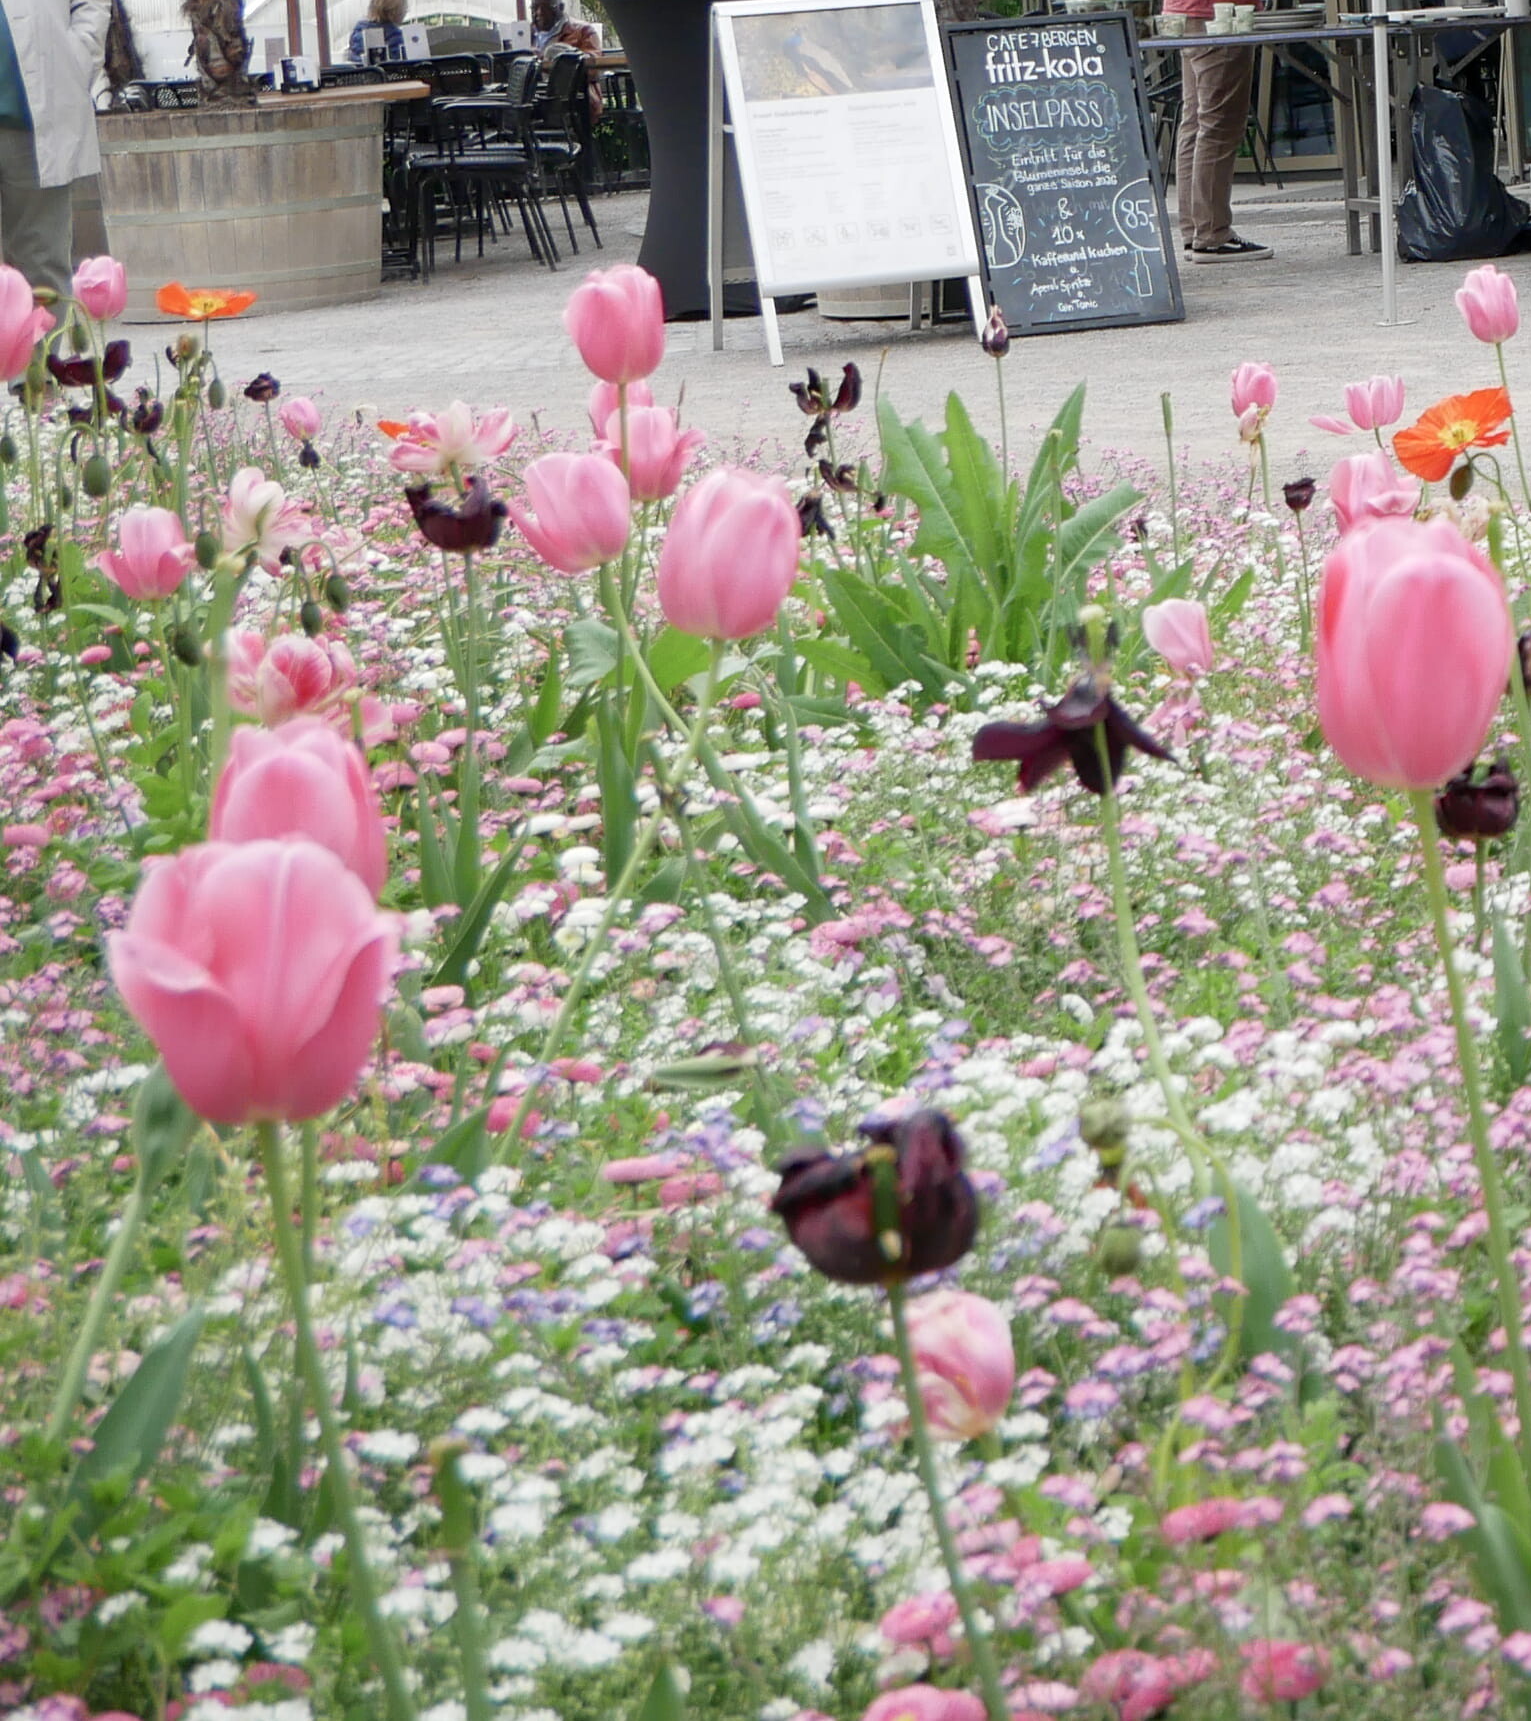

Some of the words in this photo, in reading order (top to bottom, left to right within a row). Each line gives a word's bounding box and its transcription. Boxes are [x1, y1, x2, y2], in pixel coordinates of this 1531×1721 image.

[986, 32, 1029, 52] CAFE
[1041, 29, 1098, 48] BERGEN
[985, 45, 1104, 84] fritz-kola
[986, 98, 1103, 133] INSELPASS
[1011, 148, 1058, 168] Eintritt
[1063, 146, 1084, 163] für
[1087, 144, 1106, 159] die
[1012, 161, 1090, 183] Blumeninsel
[1092, 160, 1111, 174] die
[1026, 180, 1058, 197] ganze
[1060, 177, 1094, 189] Saison
[1057, 197, 1074, 220] &
[1051, 224, 1075, 245] 10
